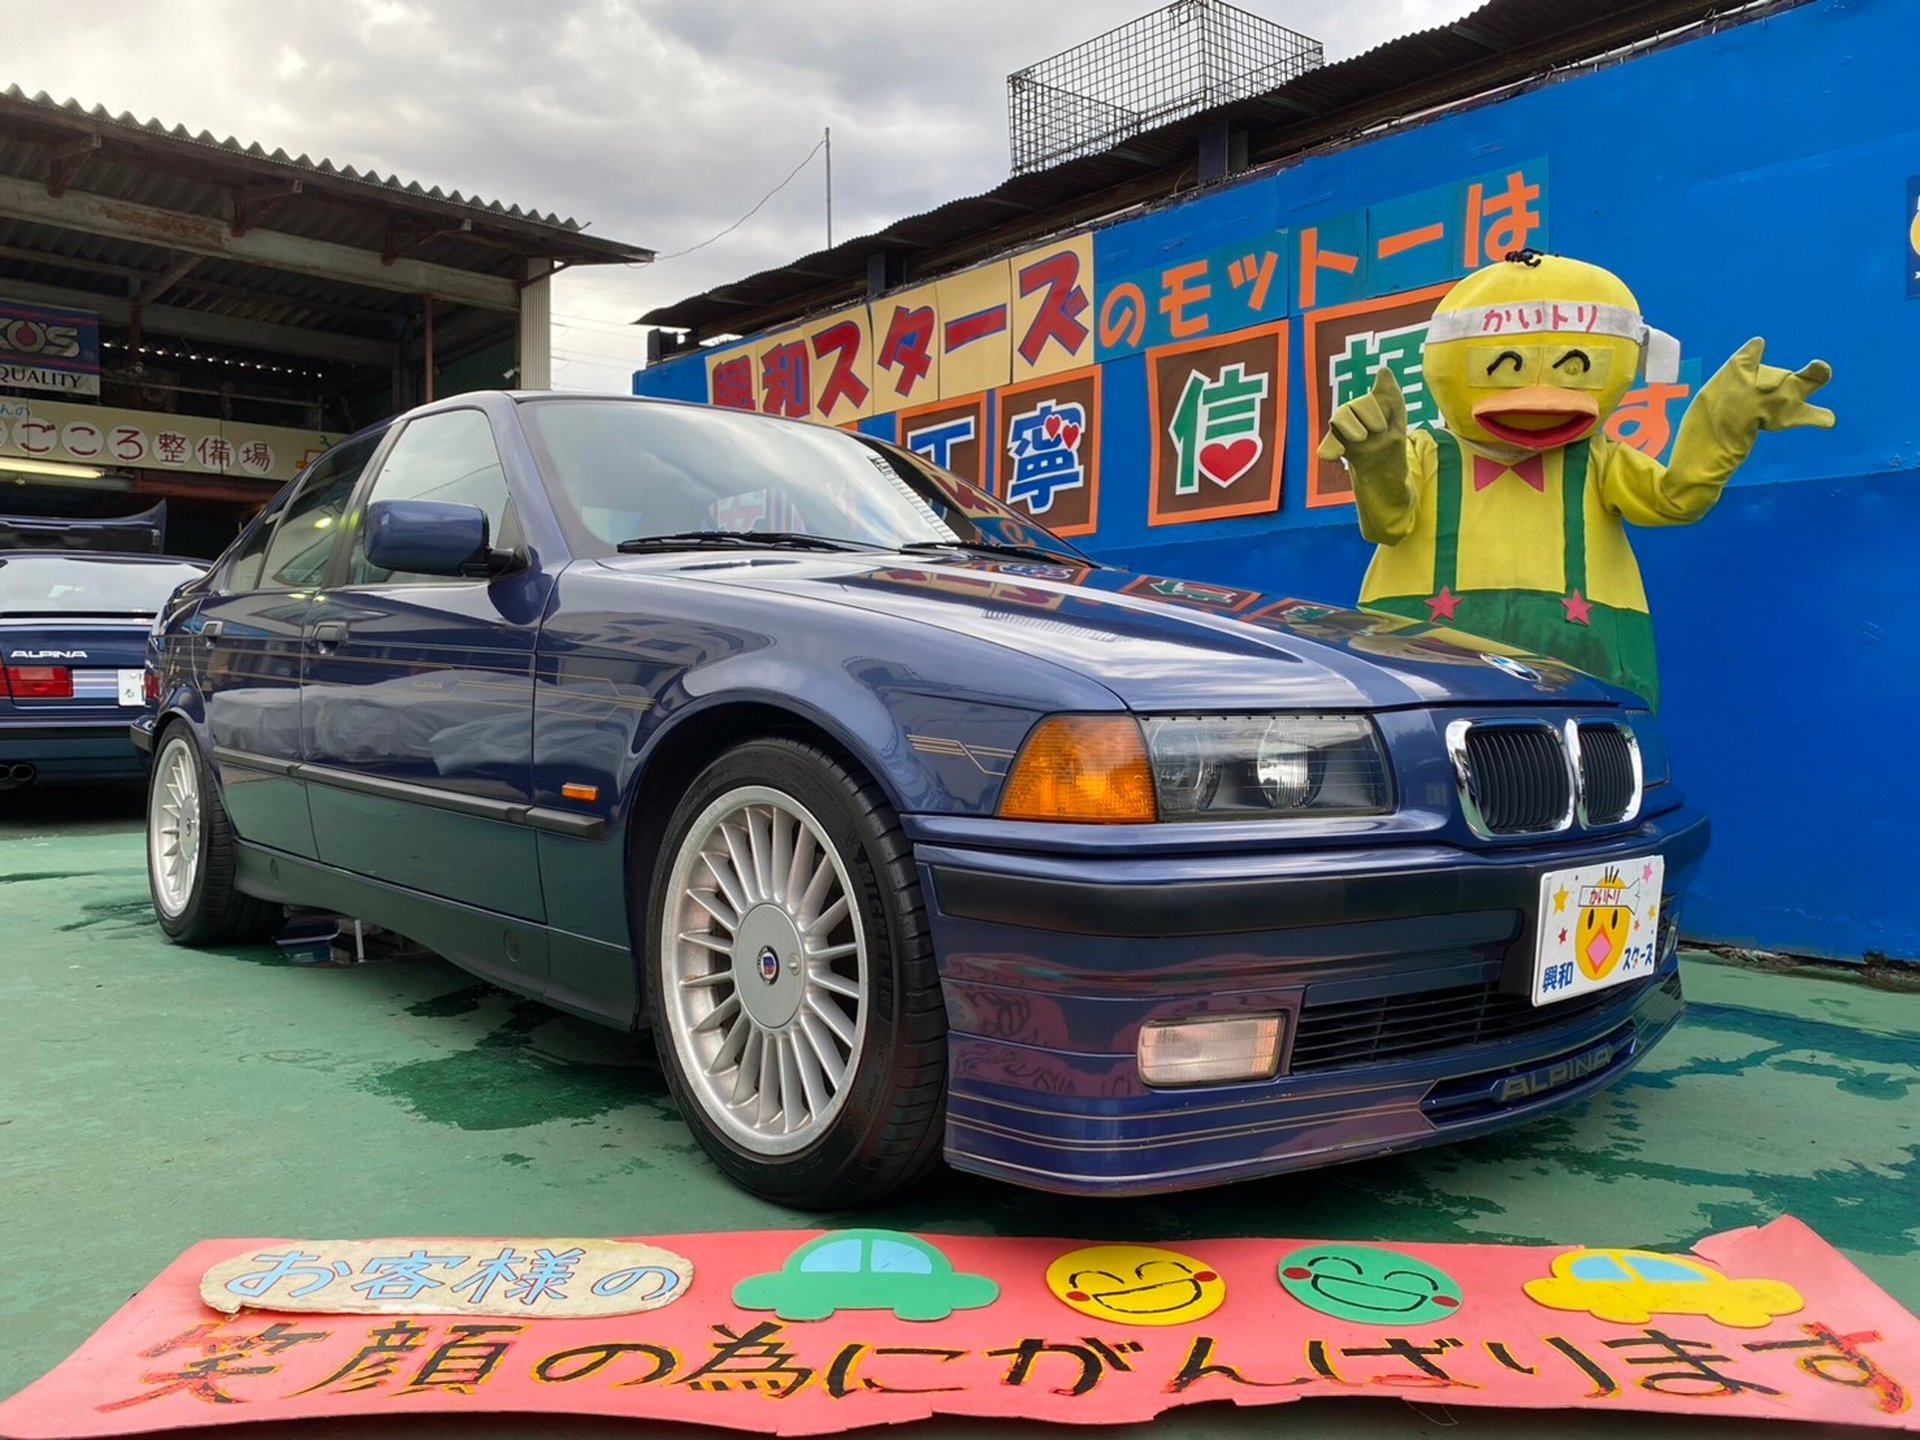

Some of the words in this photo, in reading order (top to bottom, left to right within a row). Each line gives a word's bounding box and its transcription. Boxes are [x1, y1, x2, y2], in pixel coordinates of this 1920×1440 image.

[1482, 304, 1598, 333] かいトリ
[0, 422, 271, 472] ごころ整備場
[10, 650, 88, 658] ALPINA
[1542, 961, 1574, 993] 興和
[1502, 1048, 1614, 1101] ALPINA
[226, 1247, 681, 1304] お客様の
[98, 1319, 1911, 1415] 笑顔の為にがんばります
